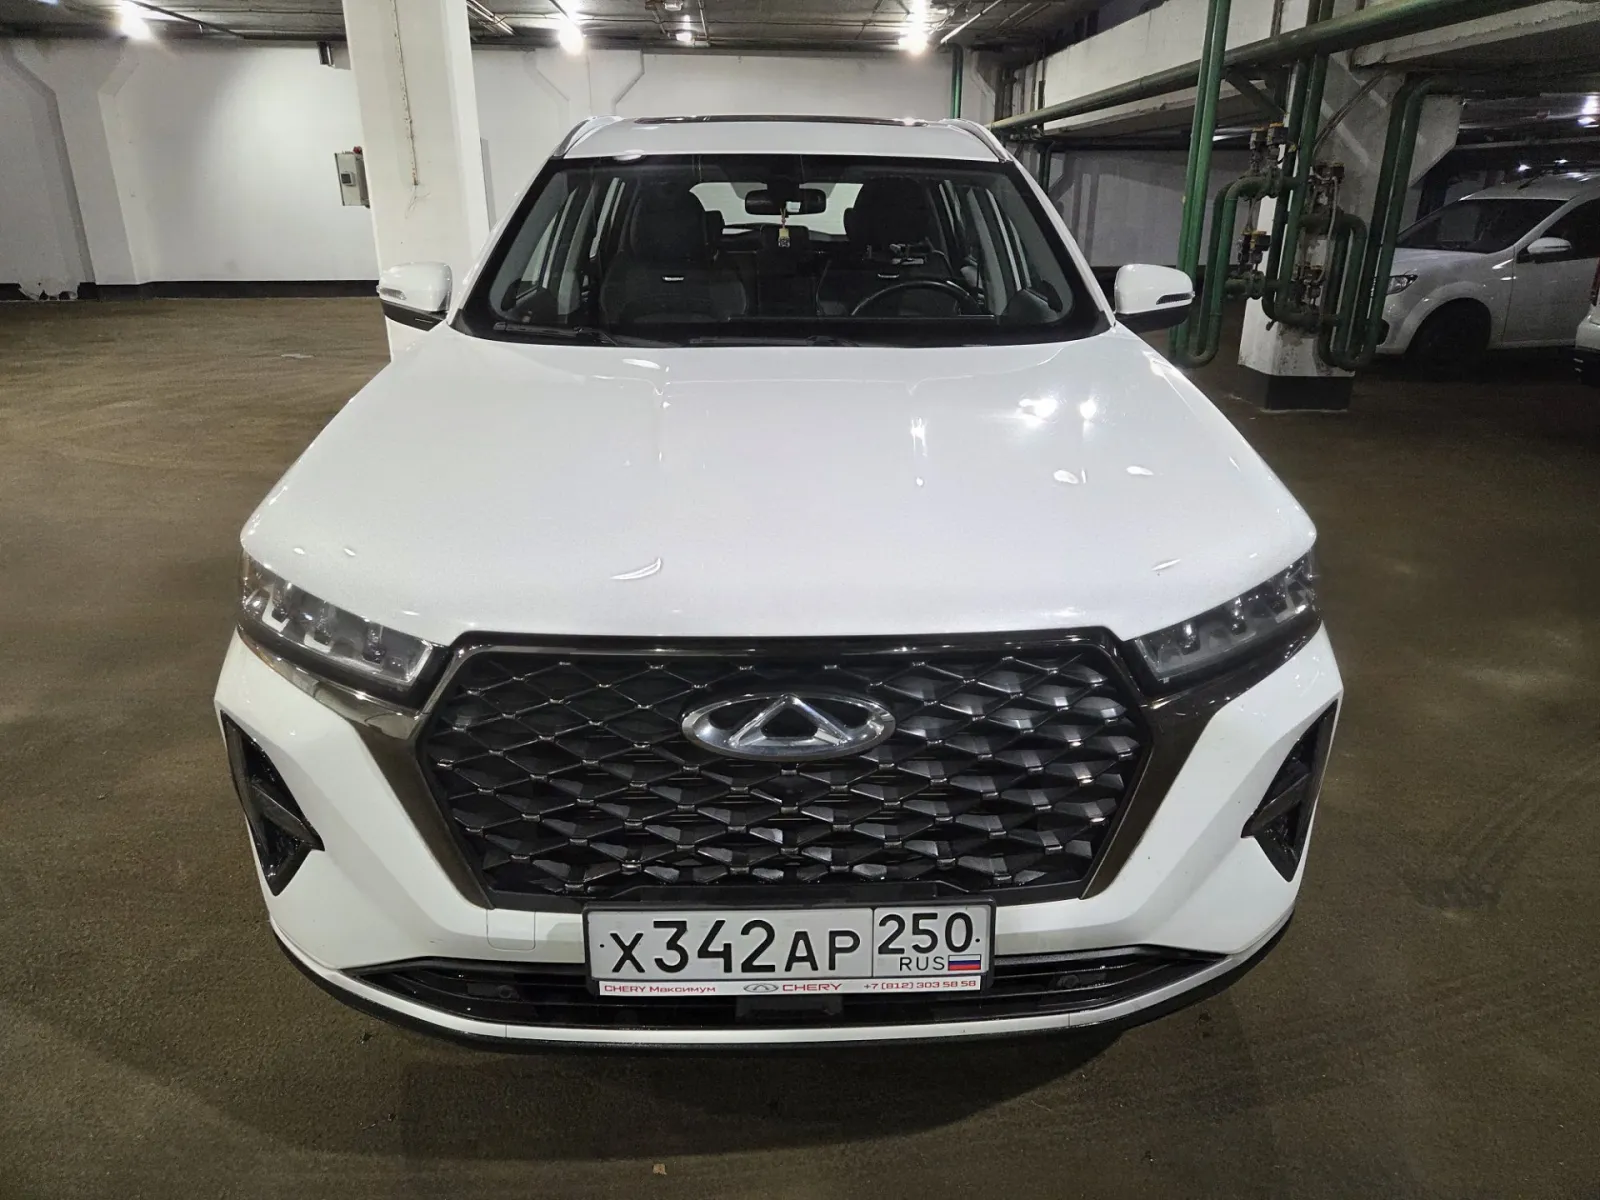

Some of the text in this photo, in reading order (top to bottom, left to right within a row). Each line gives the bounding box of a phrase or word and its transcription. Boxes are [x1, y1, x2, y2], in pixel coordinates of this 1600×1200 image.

[877, 911, 973, 955] 250
[899, 956, 945, 972] RUS
[604, 984, 646, 994] CHERY
[782, 983, 842, 992] CHERY
[881, 982, 914, 990] (812)
